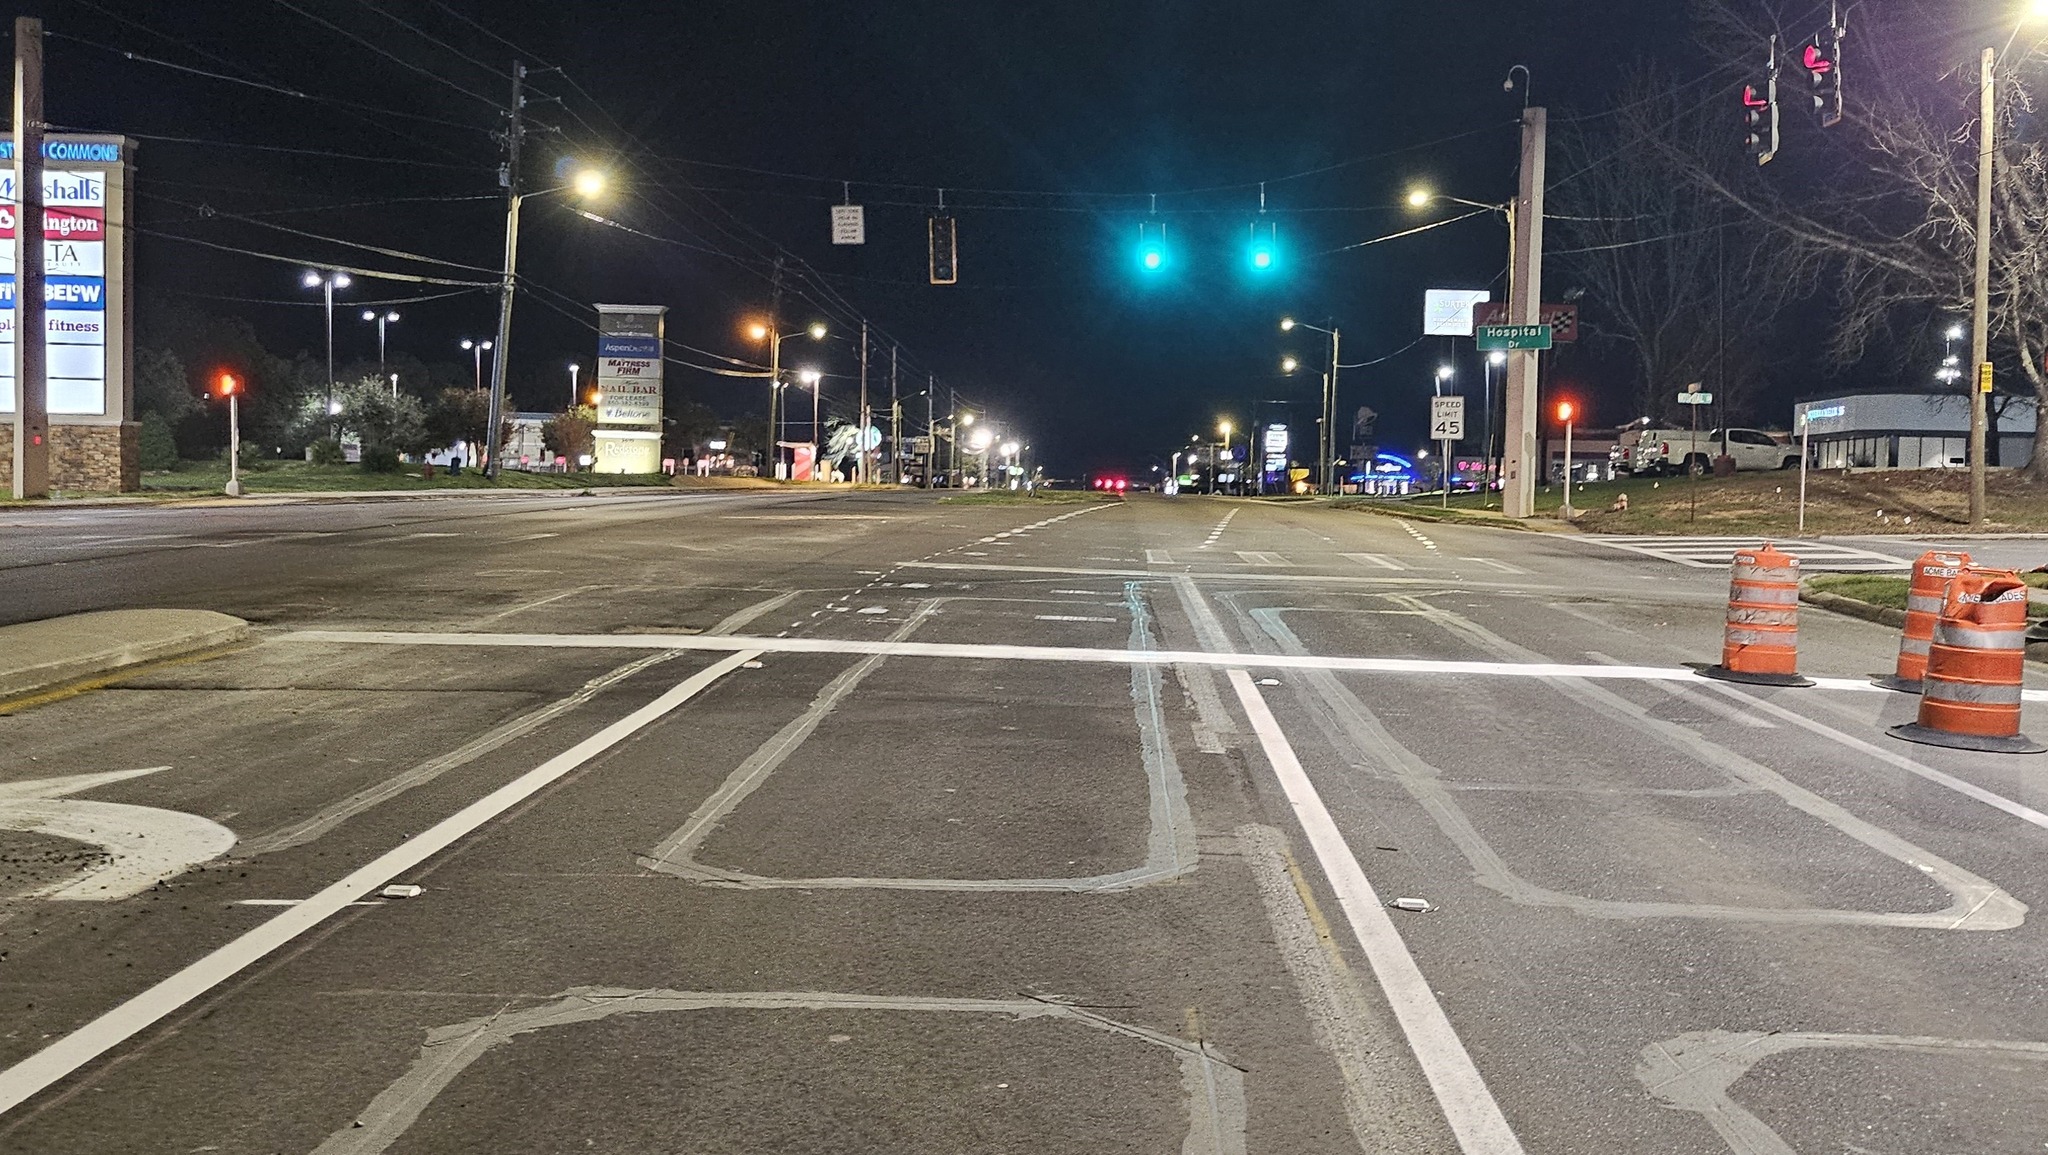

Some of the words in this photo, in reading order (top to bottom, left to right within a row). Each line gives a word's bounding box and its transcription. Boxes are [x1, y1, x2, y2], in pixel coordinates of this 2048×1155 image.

[48, 142, 118, 161] COMMONS
[48, 319, 99, 332] fitness
[1487, 326, 1542, 338] Hospital
[1508, 341, 1520, 349] Dr
[617, 367, 641, 375] FIRM
[601, 385, 628, 394] NAIL
[633, 386, 657, 394] BAR
[1435, 421, 1460, 434] 45
[1925, 567, 1944, 577] ACME
